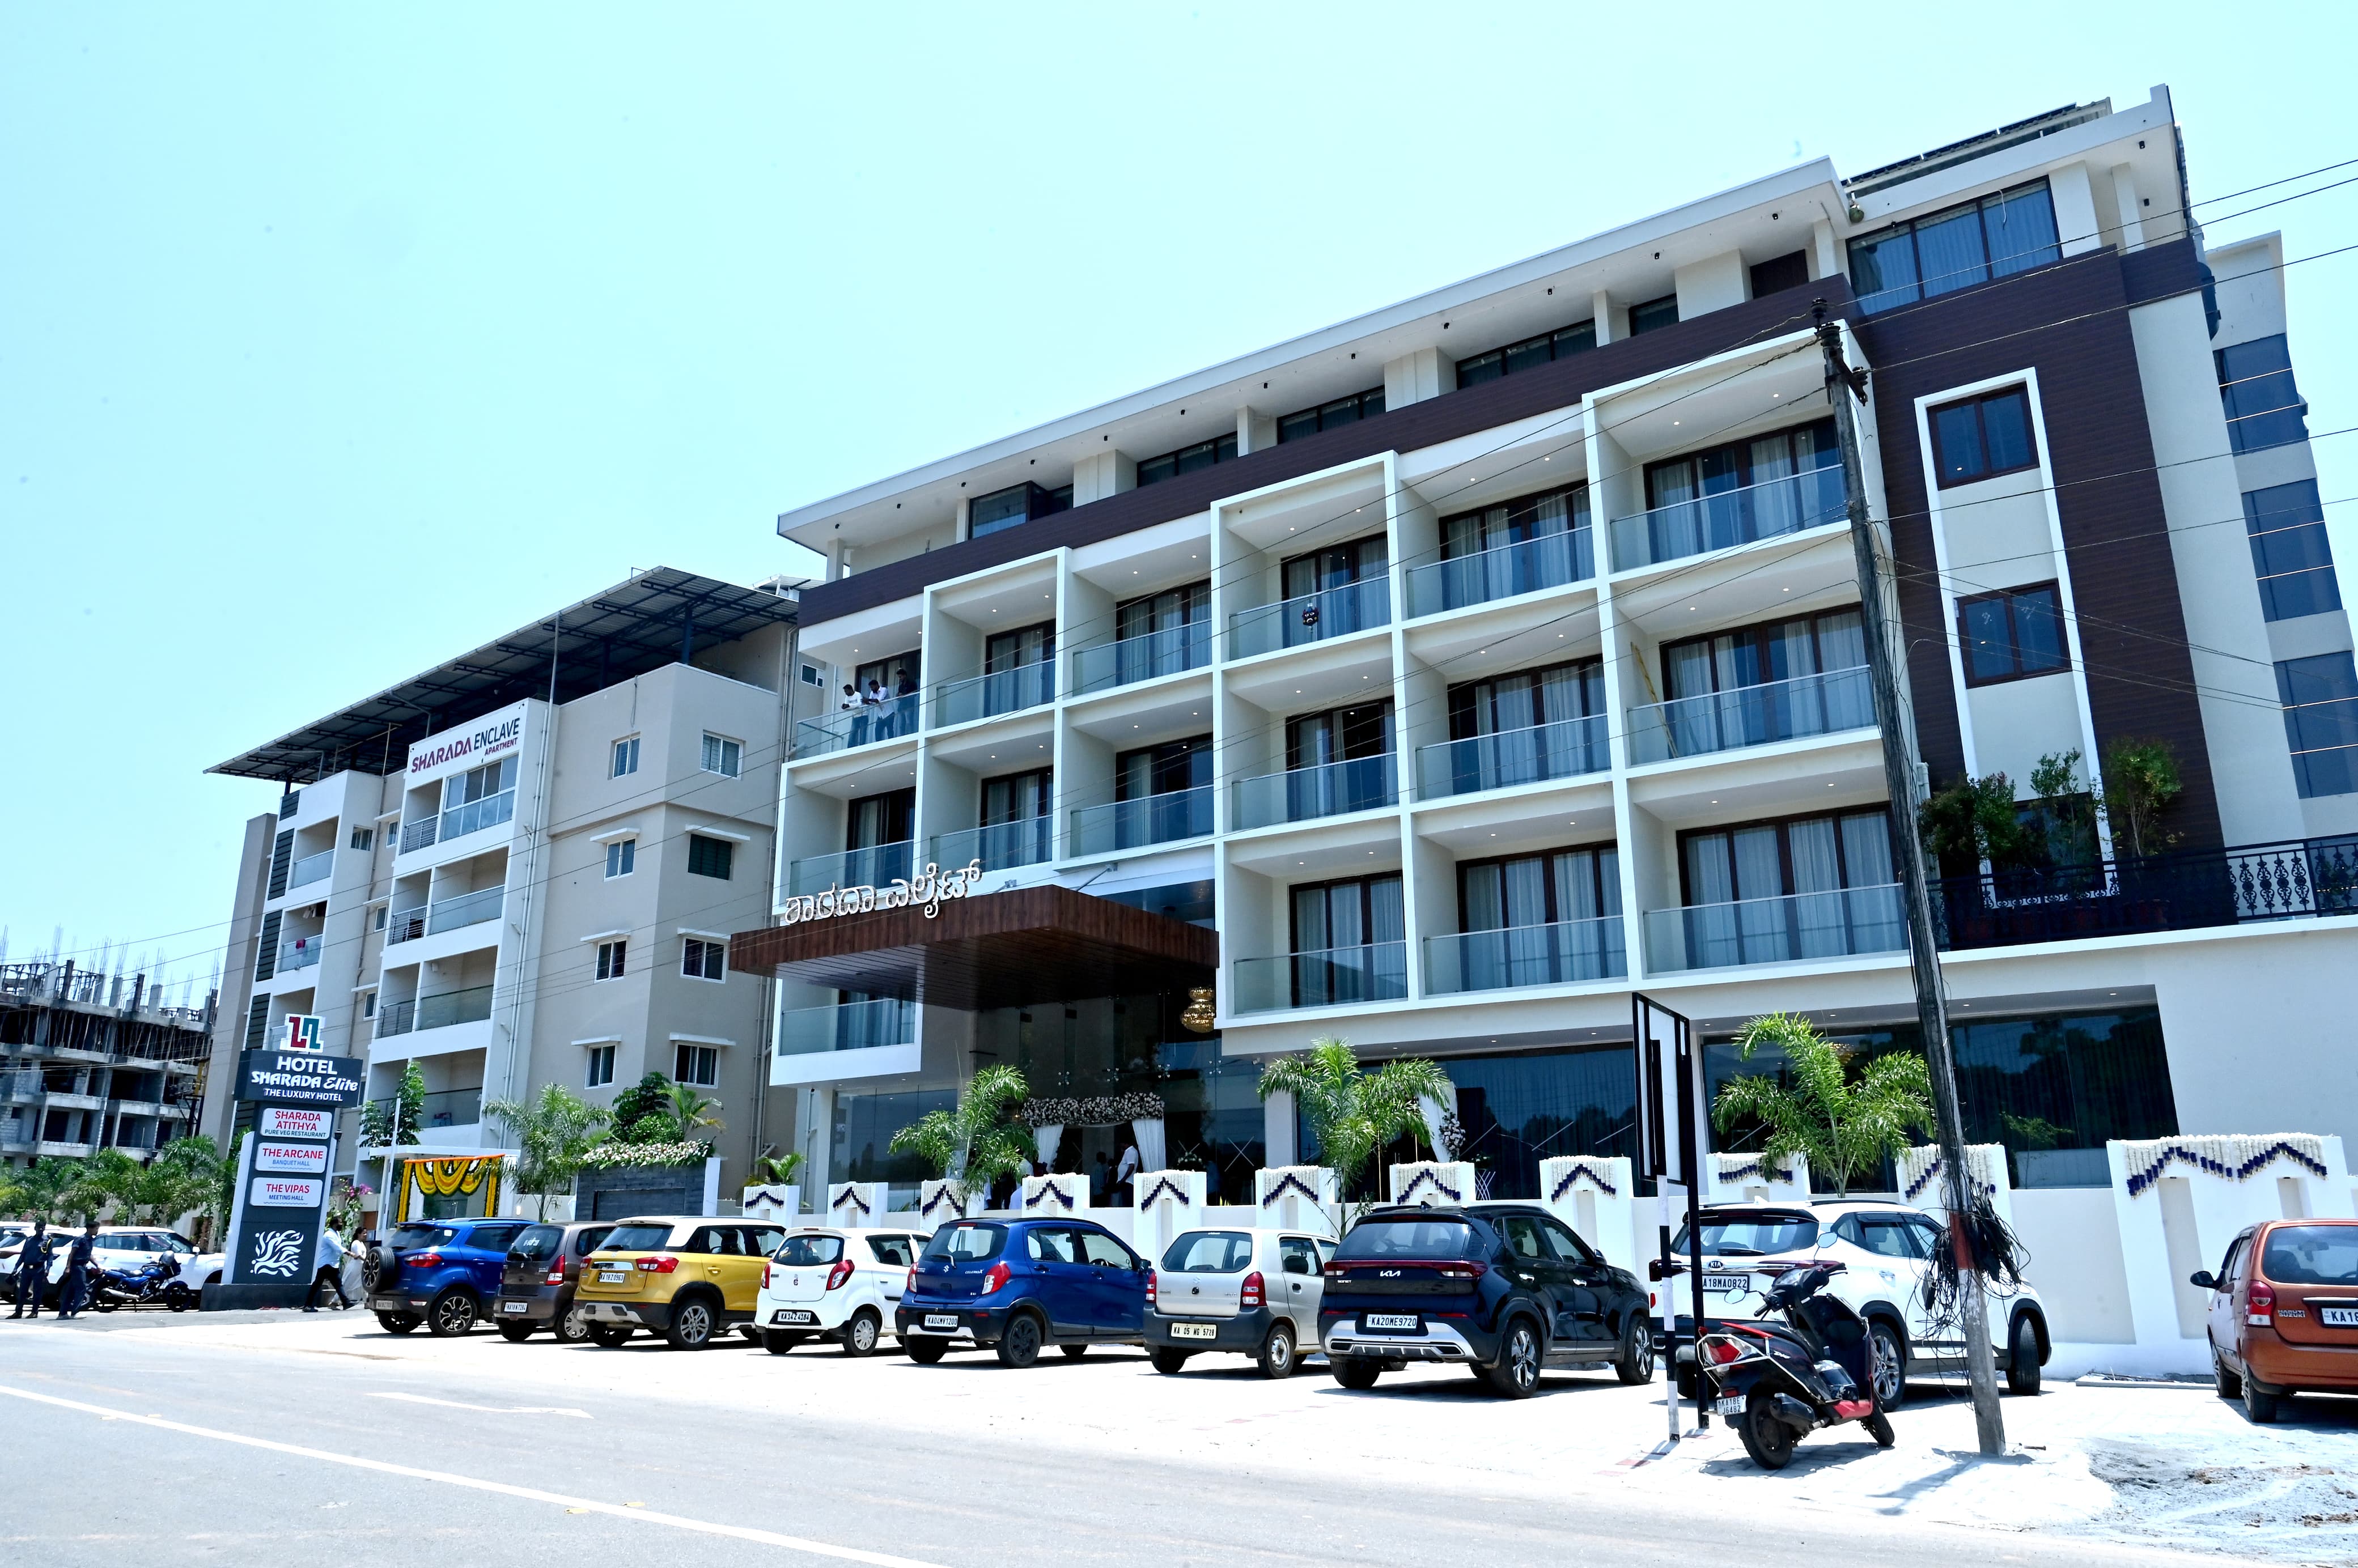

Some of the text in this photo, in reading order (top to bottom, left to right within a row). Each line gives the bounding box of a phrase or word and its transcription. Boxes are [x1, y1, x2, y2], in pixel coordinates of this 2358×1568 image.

[412, 717, 520, 773] SHARADA ENCLAVE
[485, 737, 518, 756] APARTMENT
[784, 859, 982, 924] ಶಾರದಾ ಎಲೈಟ್
[276, 1056, 338, 1075] HOTEL
[251, 1071, 358, 1091] SHARADA Elite
[264, 1088, 343, 1102] THE LUXURY HOTEL
[275, 1111, 321, 1121] SHARADA
[276, 1121, 317, 1131] ATITHYA
[262, 1148, 324, 1159] THE ARCANE
[266, 1184, 309, 1193] THE VIPAS
[1703, 1278, 1747, 1288] A18MA0822
[1371, 1317, 1417, 1327] KA20ME9720
